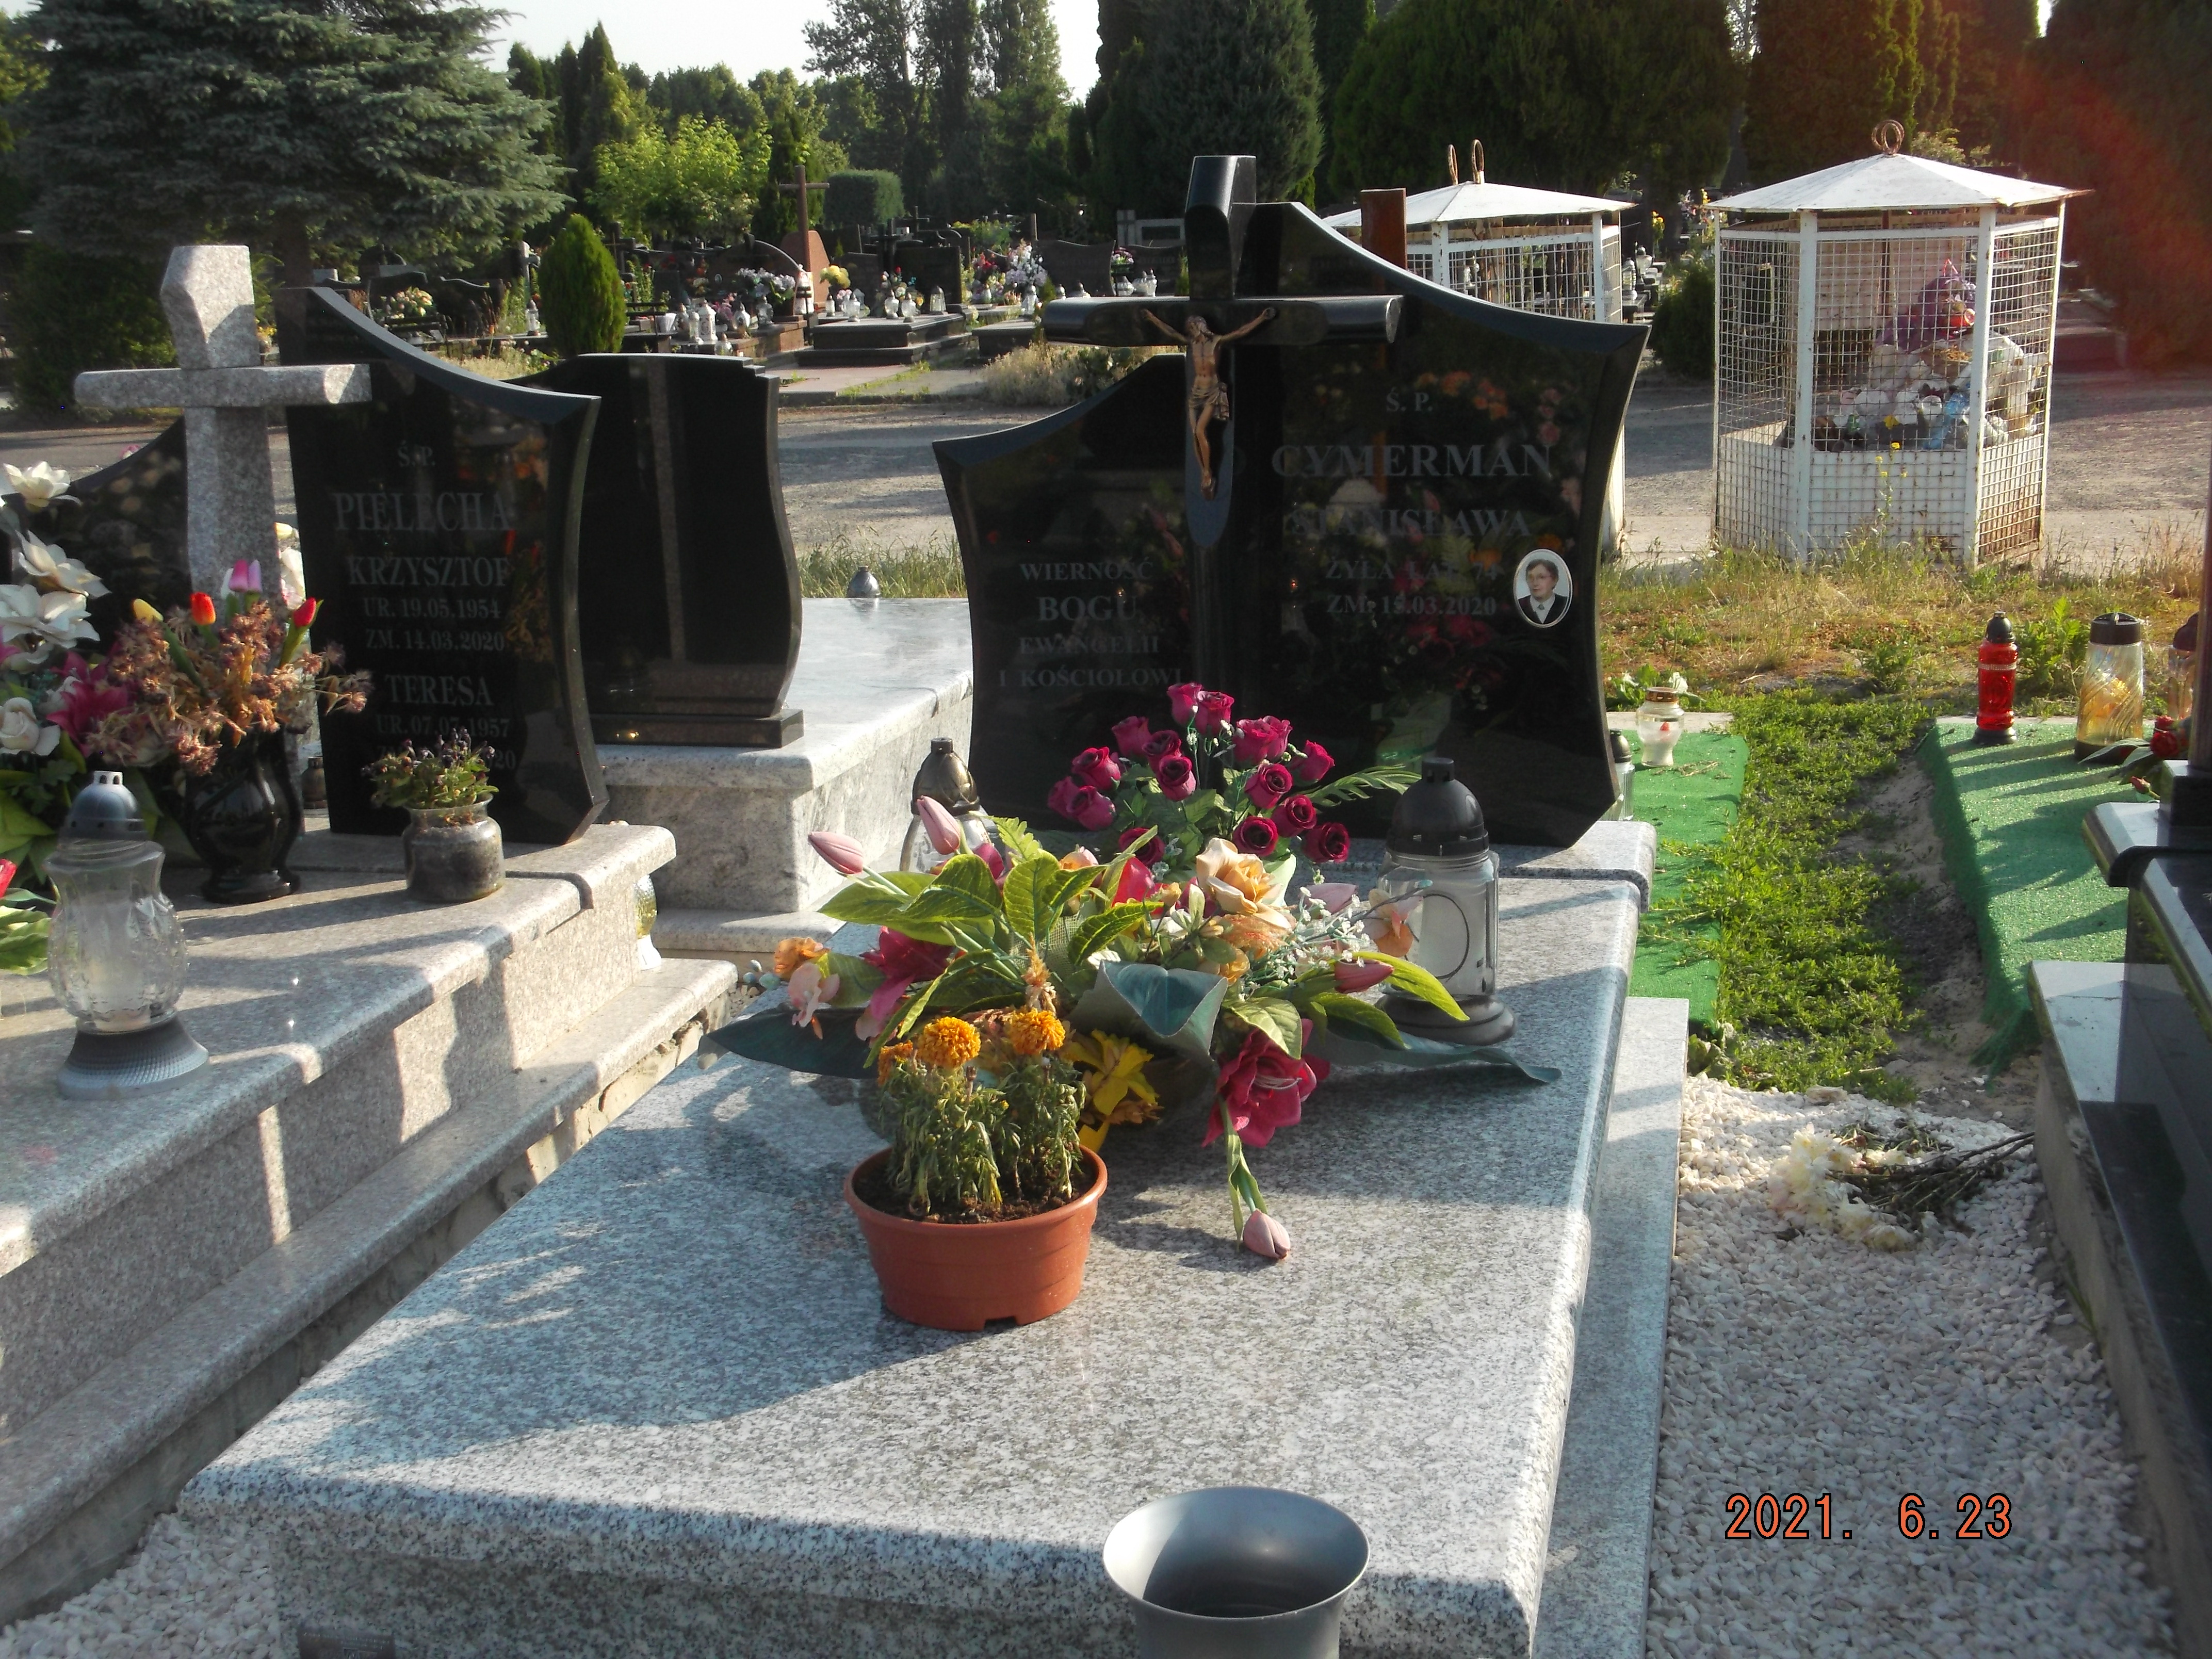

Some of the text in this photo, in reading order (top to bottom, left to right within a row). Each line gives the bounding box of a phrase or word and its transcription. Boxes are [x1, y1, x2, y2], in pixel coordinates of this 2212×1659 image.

[1272, 444, 1553, 477] CYMERMAN
[333, 492, 512, 532] PIELECHA
[1290, 509, 1532, 537] STANISŁAWA
[346, 556, 509, 587] KRZYSZTOF
[1019, 557, 1153, 581] WIERNOŚĆ
[1325, 557, 1395, 579] ŻYŁA
[1408, 561, 1457, 580] LAT
[363, 597, 501, 620] UR. 19.05.1954
[365, 628, 505, 652] ZM. 14.03.2020
[1019, 636, 1160, 655] EWANGELII
[384, 675, 494, 707] TERESA
[411, 715, 511, 738] 07.071957
